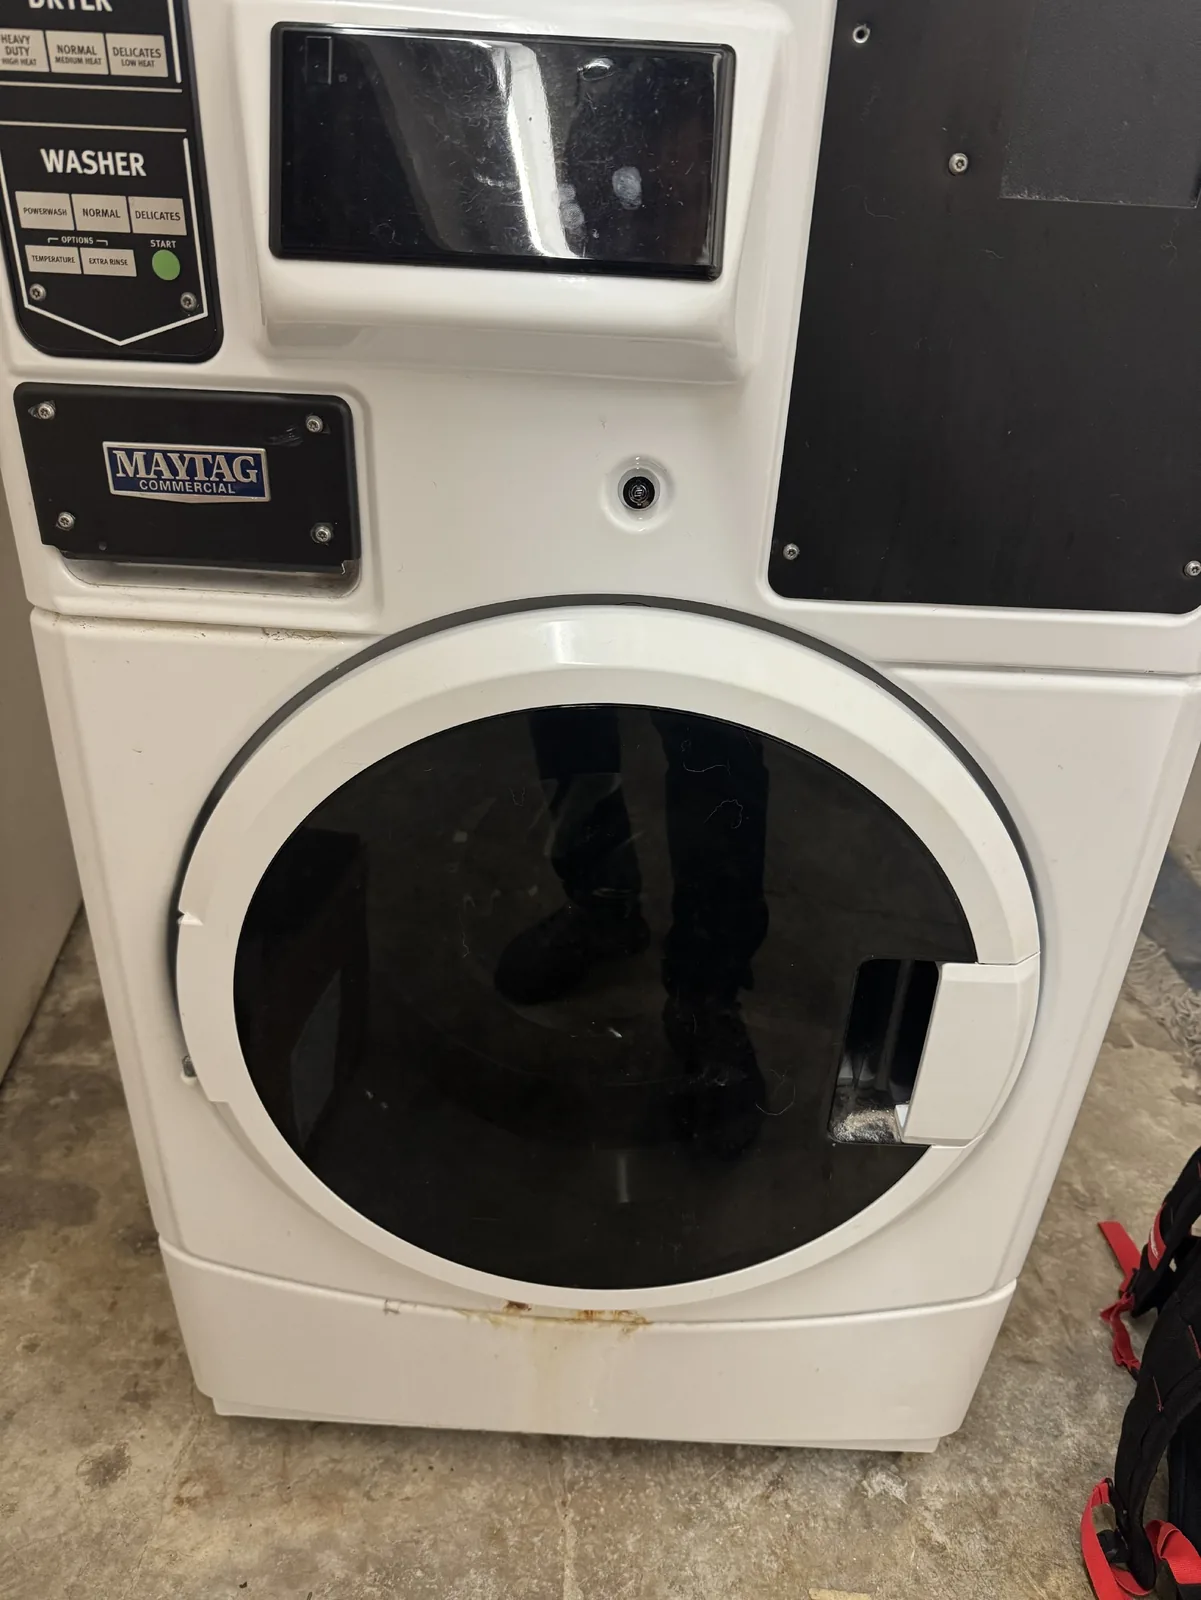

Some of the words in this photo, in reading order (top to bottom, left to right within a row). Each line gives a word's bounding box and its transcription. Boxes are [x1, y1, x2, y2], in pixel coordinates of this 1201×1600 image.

[0, 34, 31, 45] HEAVY
[5, 46, 30, 57] DUTY
[56, 44, 98, 56] NORMAL
[112, 47, 161, 59] DELICATES
[2, 58, 19, 66] HIGH
[20, 58, 37, 66] HEAT
[54, 56, 83, 65] MEDIUM
[84, 57, 102, 66] HEAT
[121, 59, 137, 68] LOW
[137, 60, 155, 68] HEAT
[40, 148, 147, 176] WASHER
[23, 207, 67, 216] POWERWASH
[82, 208, 121, 219] NORMAL
[135, 210, 181, 221] DELICATES
[61, 236, 94, 245] OPTIONS
[150, 239, 176, 249] START
[31, 255, 76, 264] TEMPERATURE
[88, 257, 109, 265] EXTRA
[109, 258, 128, 266] RINSE
[112, 450, 258, 484] MAYTAG
[139, 479, 236, 494] COMMERCIAL
